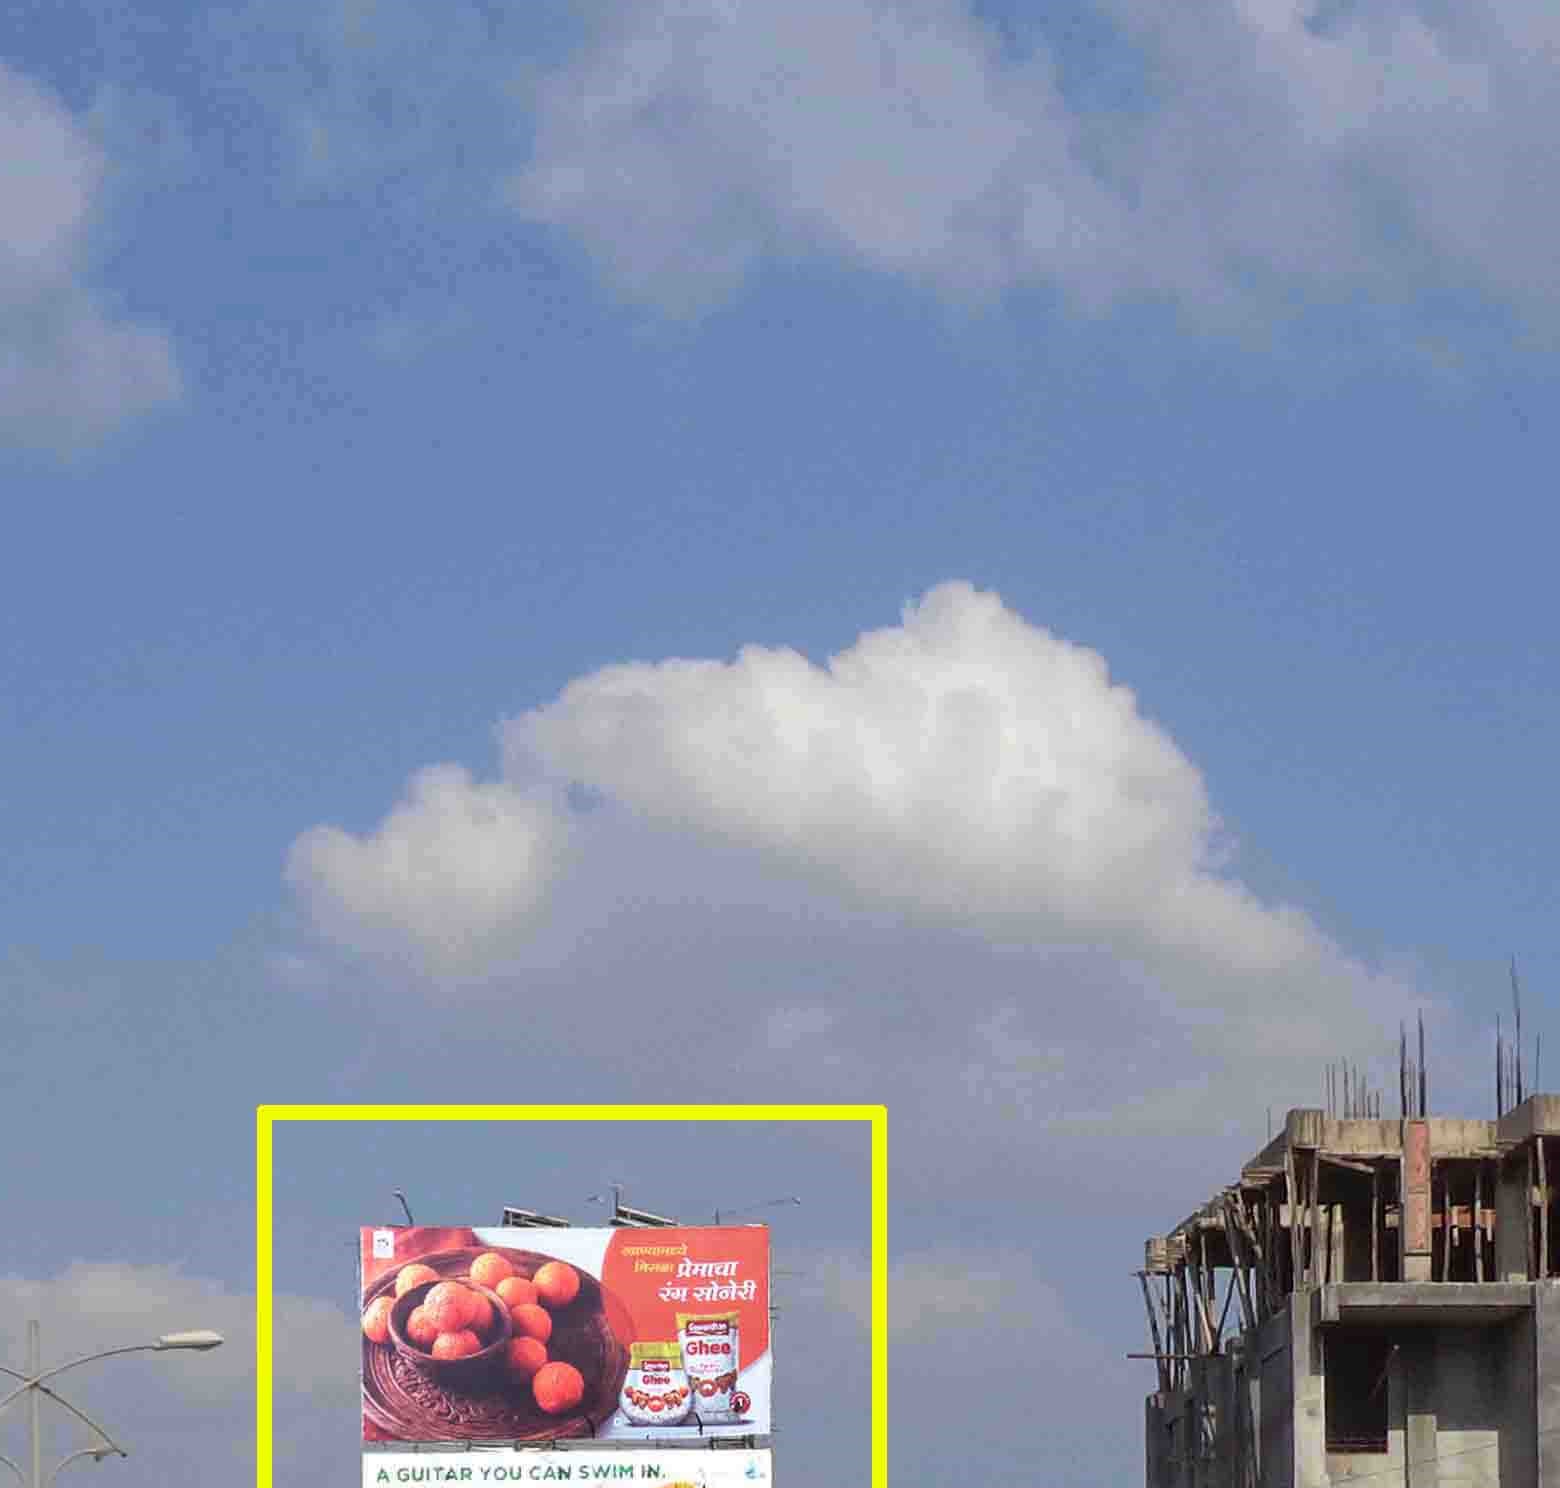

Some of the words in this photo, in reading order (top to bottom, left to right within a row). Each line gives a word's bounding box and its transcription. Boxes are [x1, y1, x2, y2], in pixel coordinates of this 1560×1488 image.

[657, 1281, 688, 1302] रंग
[691, 1279, 757, 1302] सोनेरी
[686, 1340, 731, 1355] Ghee
[376, 1468, 390, 1482] A
[397, 1467, 473, 1482] GUITAR
[480, 1466, 523, 1481] YOU
[528, 1465, 572, 1481] CAN
[578, 1464, 634, 1480] SWIM
[640, 1464, 667, 1479] IN.
